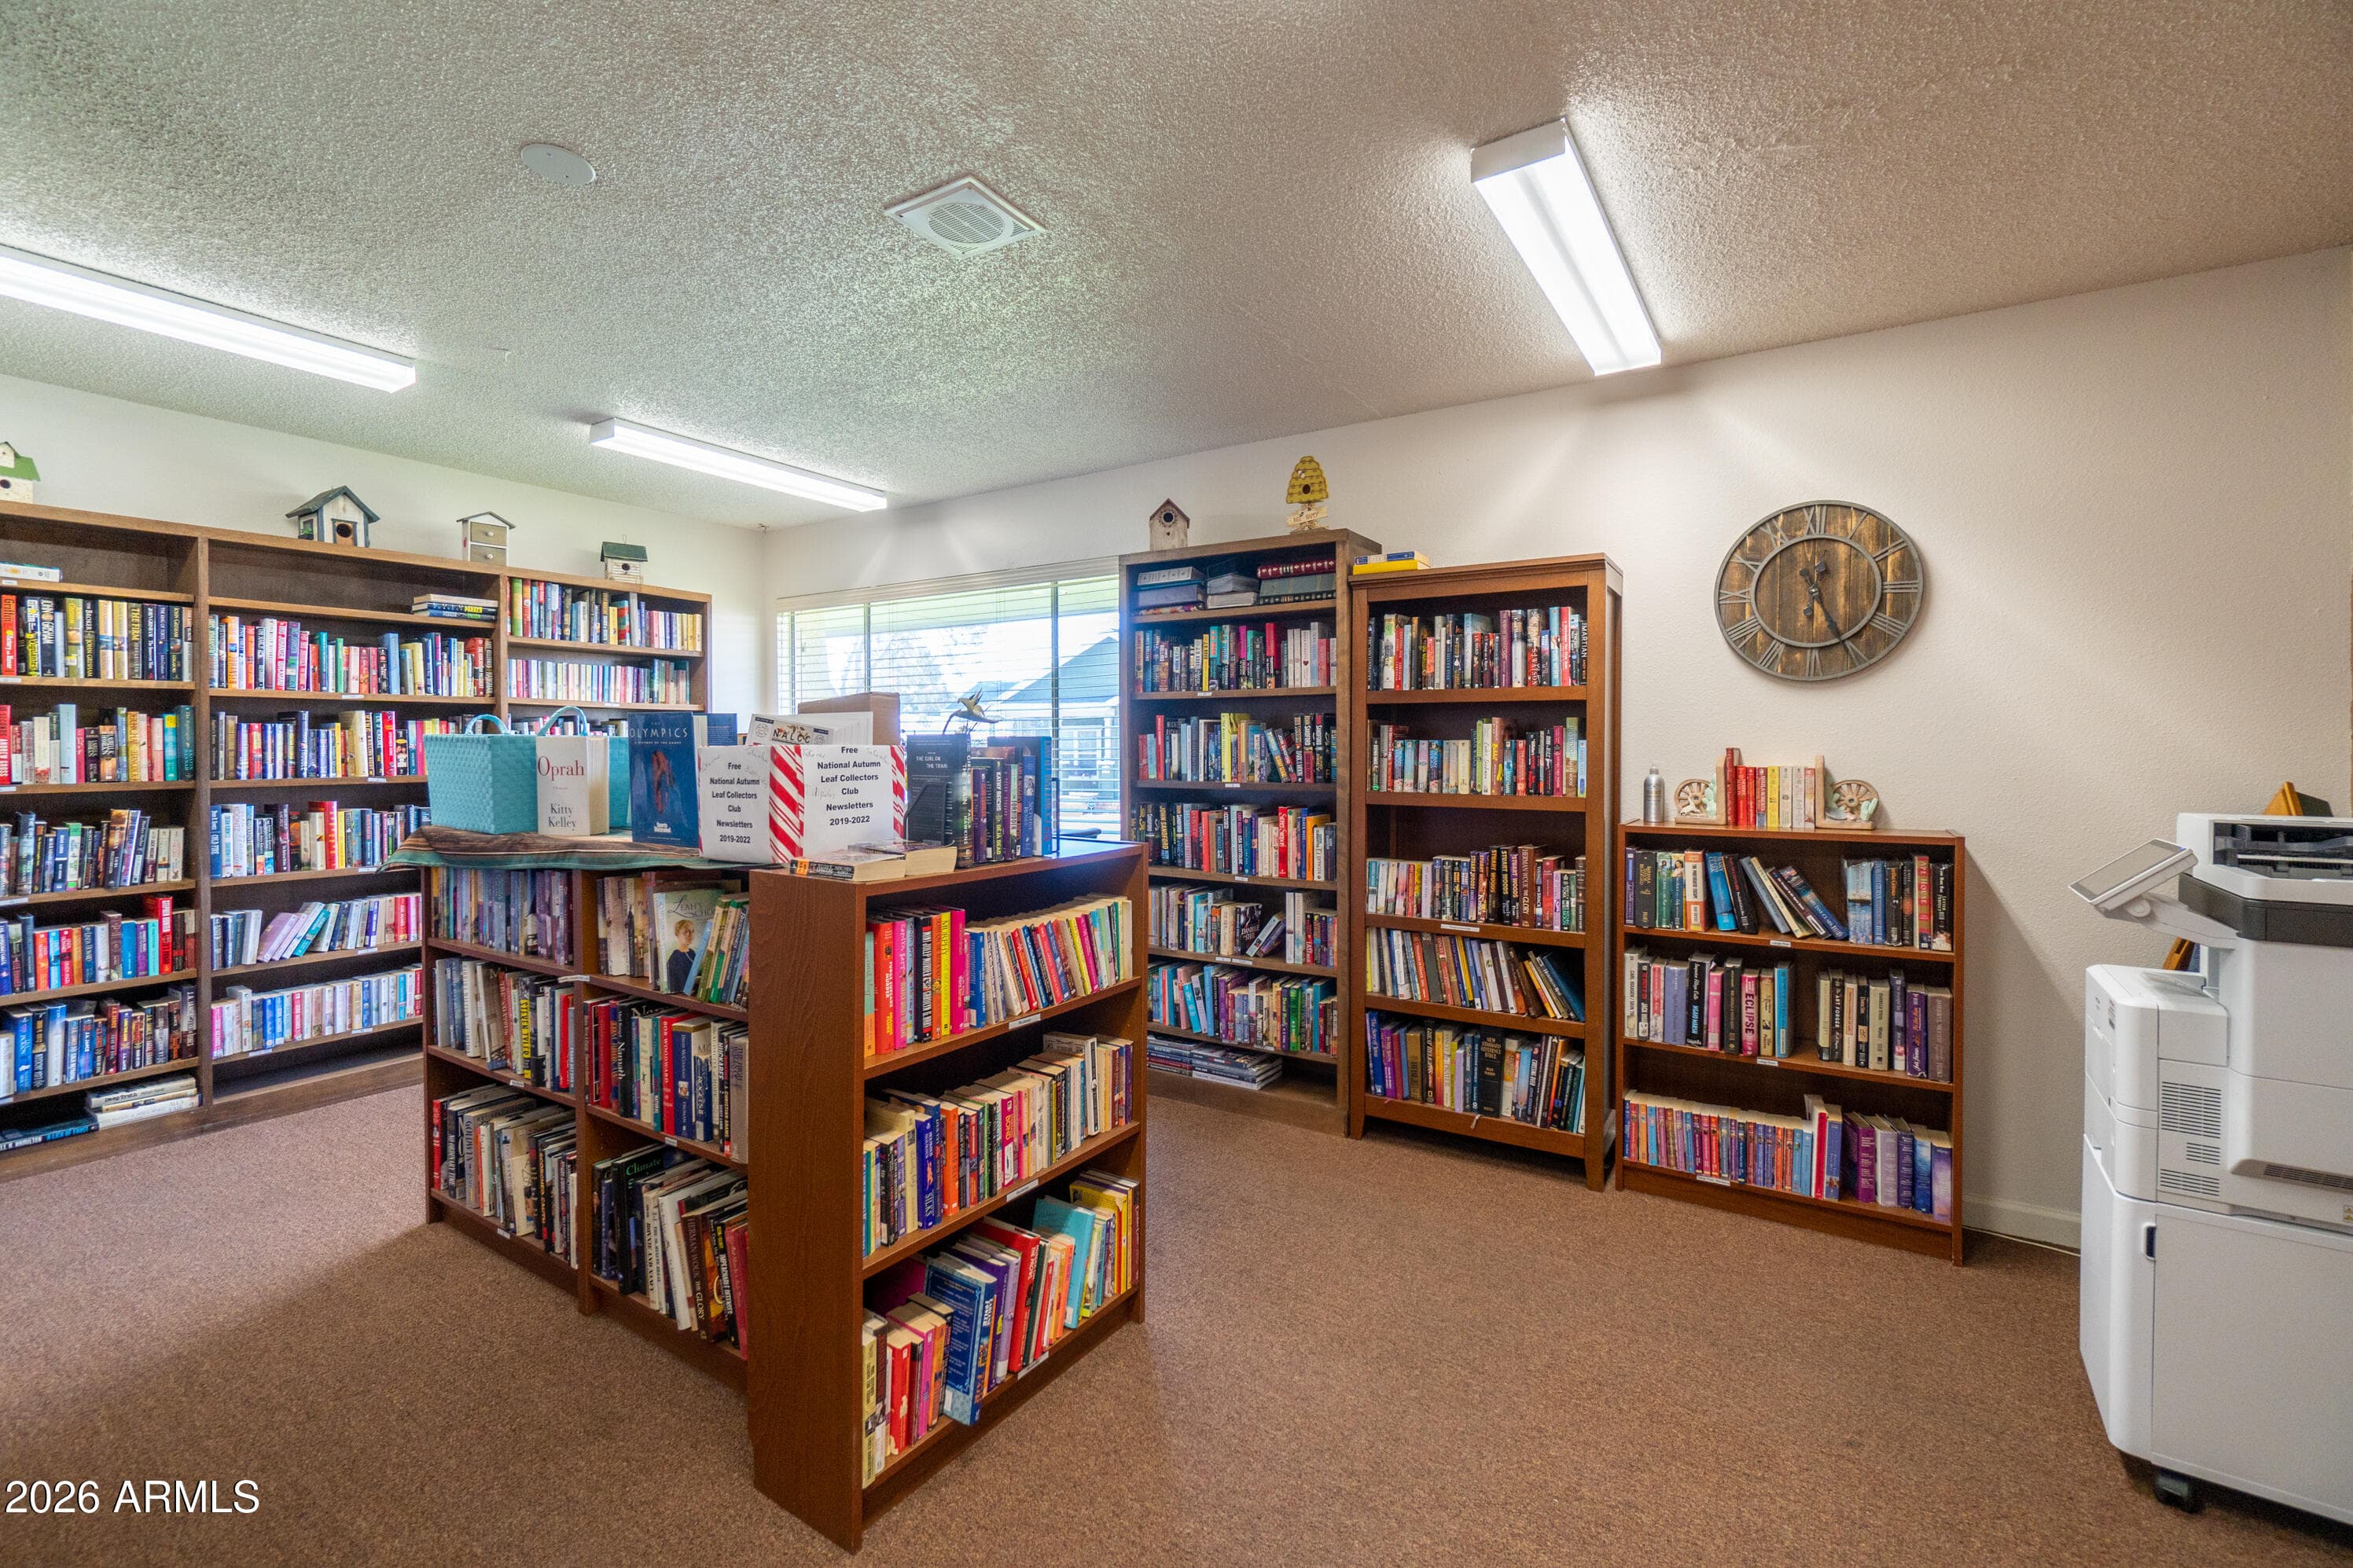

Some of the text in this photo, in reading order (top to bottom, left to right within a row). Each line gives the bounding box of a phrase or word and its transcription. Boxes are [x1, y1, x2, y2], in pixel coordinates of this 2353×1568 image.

[4, 599, 14, 622] Griffin
[42, 600, 54, 644] JOHN GRISHAM
[630, 727, 688, 738] OLYMPICS
[538, 756, 585, 780] Oprah
[550, 803, 573, 817] Kitty
[826, 802, 873, 811] Newsletters
[548, 817, 576, 831] Kelley
[717, 820, 752, 828] Newsletters
[830, 816, 870, 825] 2019-2022
[520, 1001, 528, 1030] STEVEN
[1745, 993, 1755, 1034] ECLIPSE
[626, 1157, 661, 1177] Climate
[696, 1292, 704, 1320] GLORY
